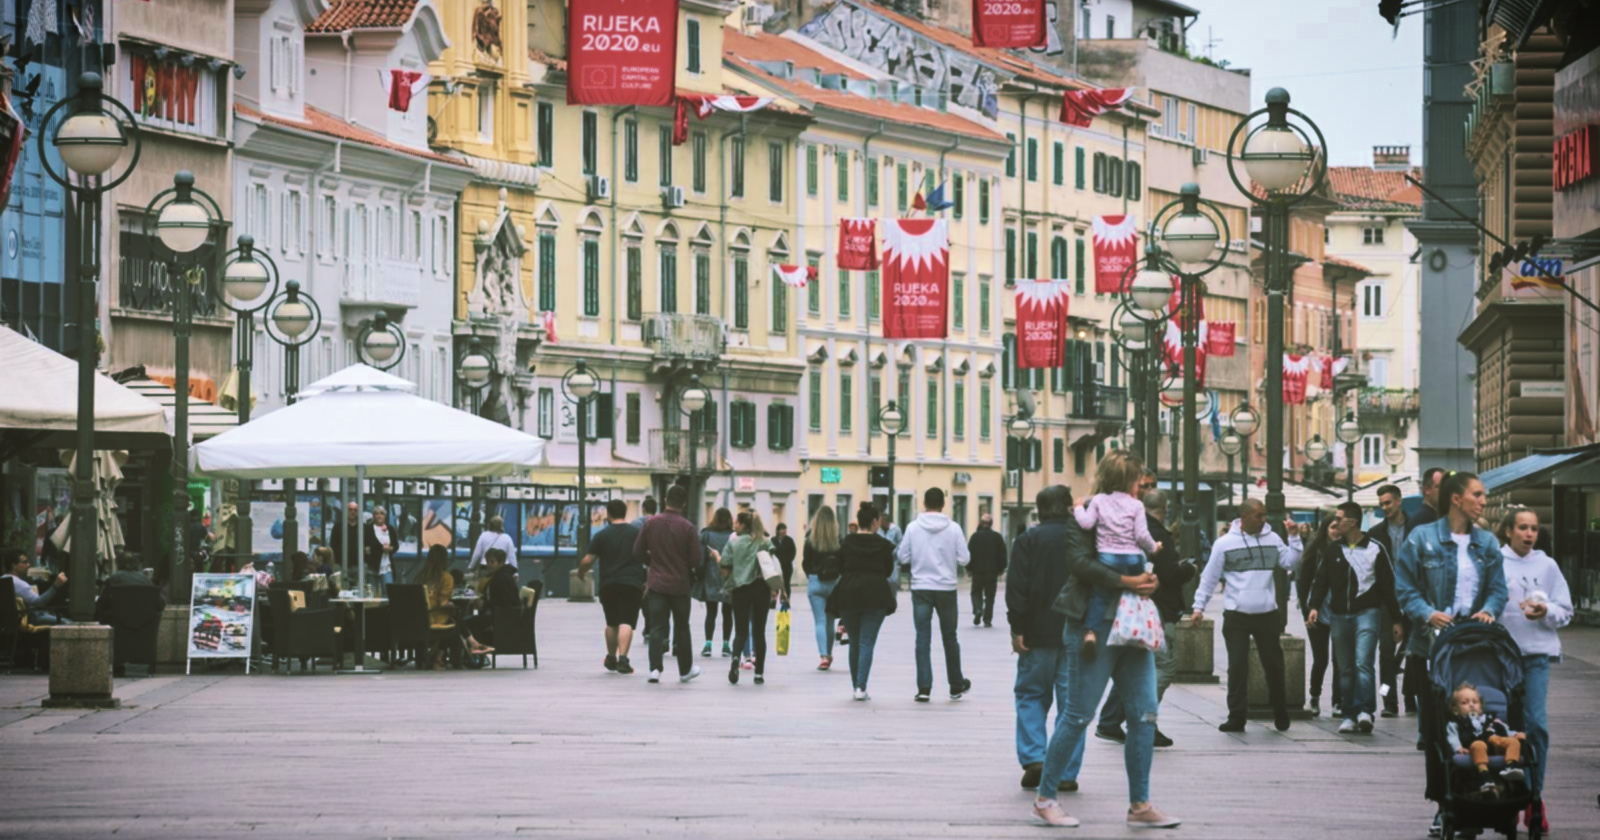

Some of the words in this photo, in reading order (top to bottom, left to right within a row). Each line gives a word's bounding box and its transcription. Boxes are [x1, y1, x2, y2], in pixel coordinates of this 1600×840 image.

[984, 3, 1035, 15] 2020.eu
[583, 15, 661, 33] RIJEKA
[582, 34, 660, 52] 2020.eu
[622, 66, 660, 74] EUROPEAN
[621, 82, 652, 90] CULTURE
[1553, 125, 1591, 191] ROBNA
[1519, 253, 1562, 277] dm
[893, 282, 940, 294] RIJEKA
[893, 295, 940, 307] 2020.eu
